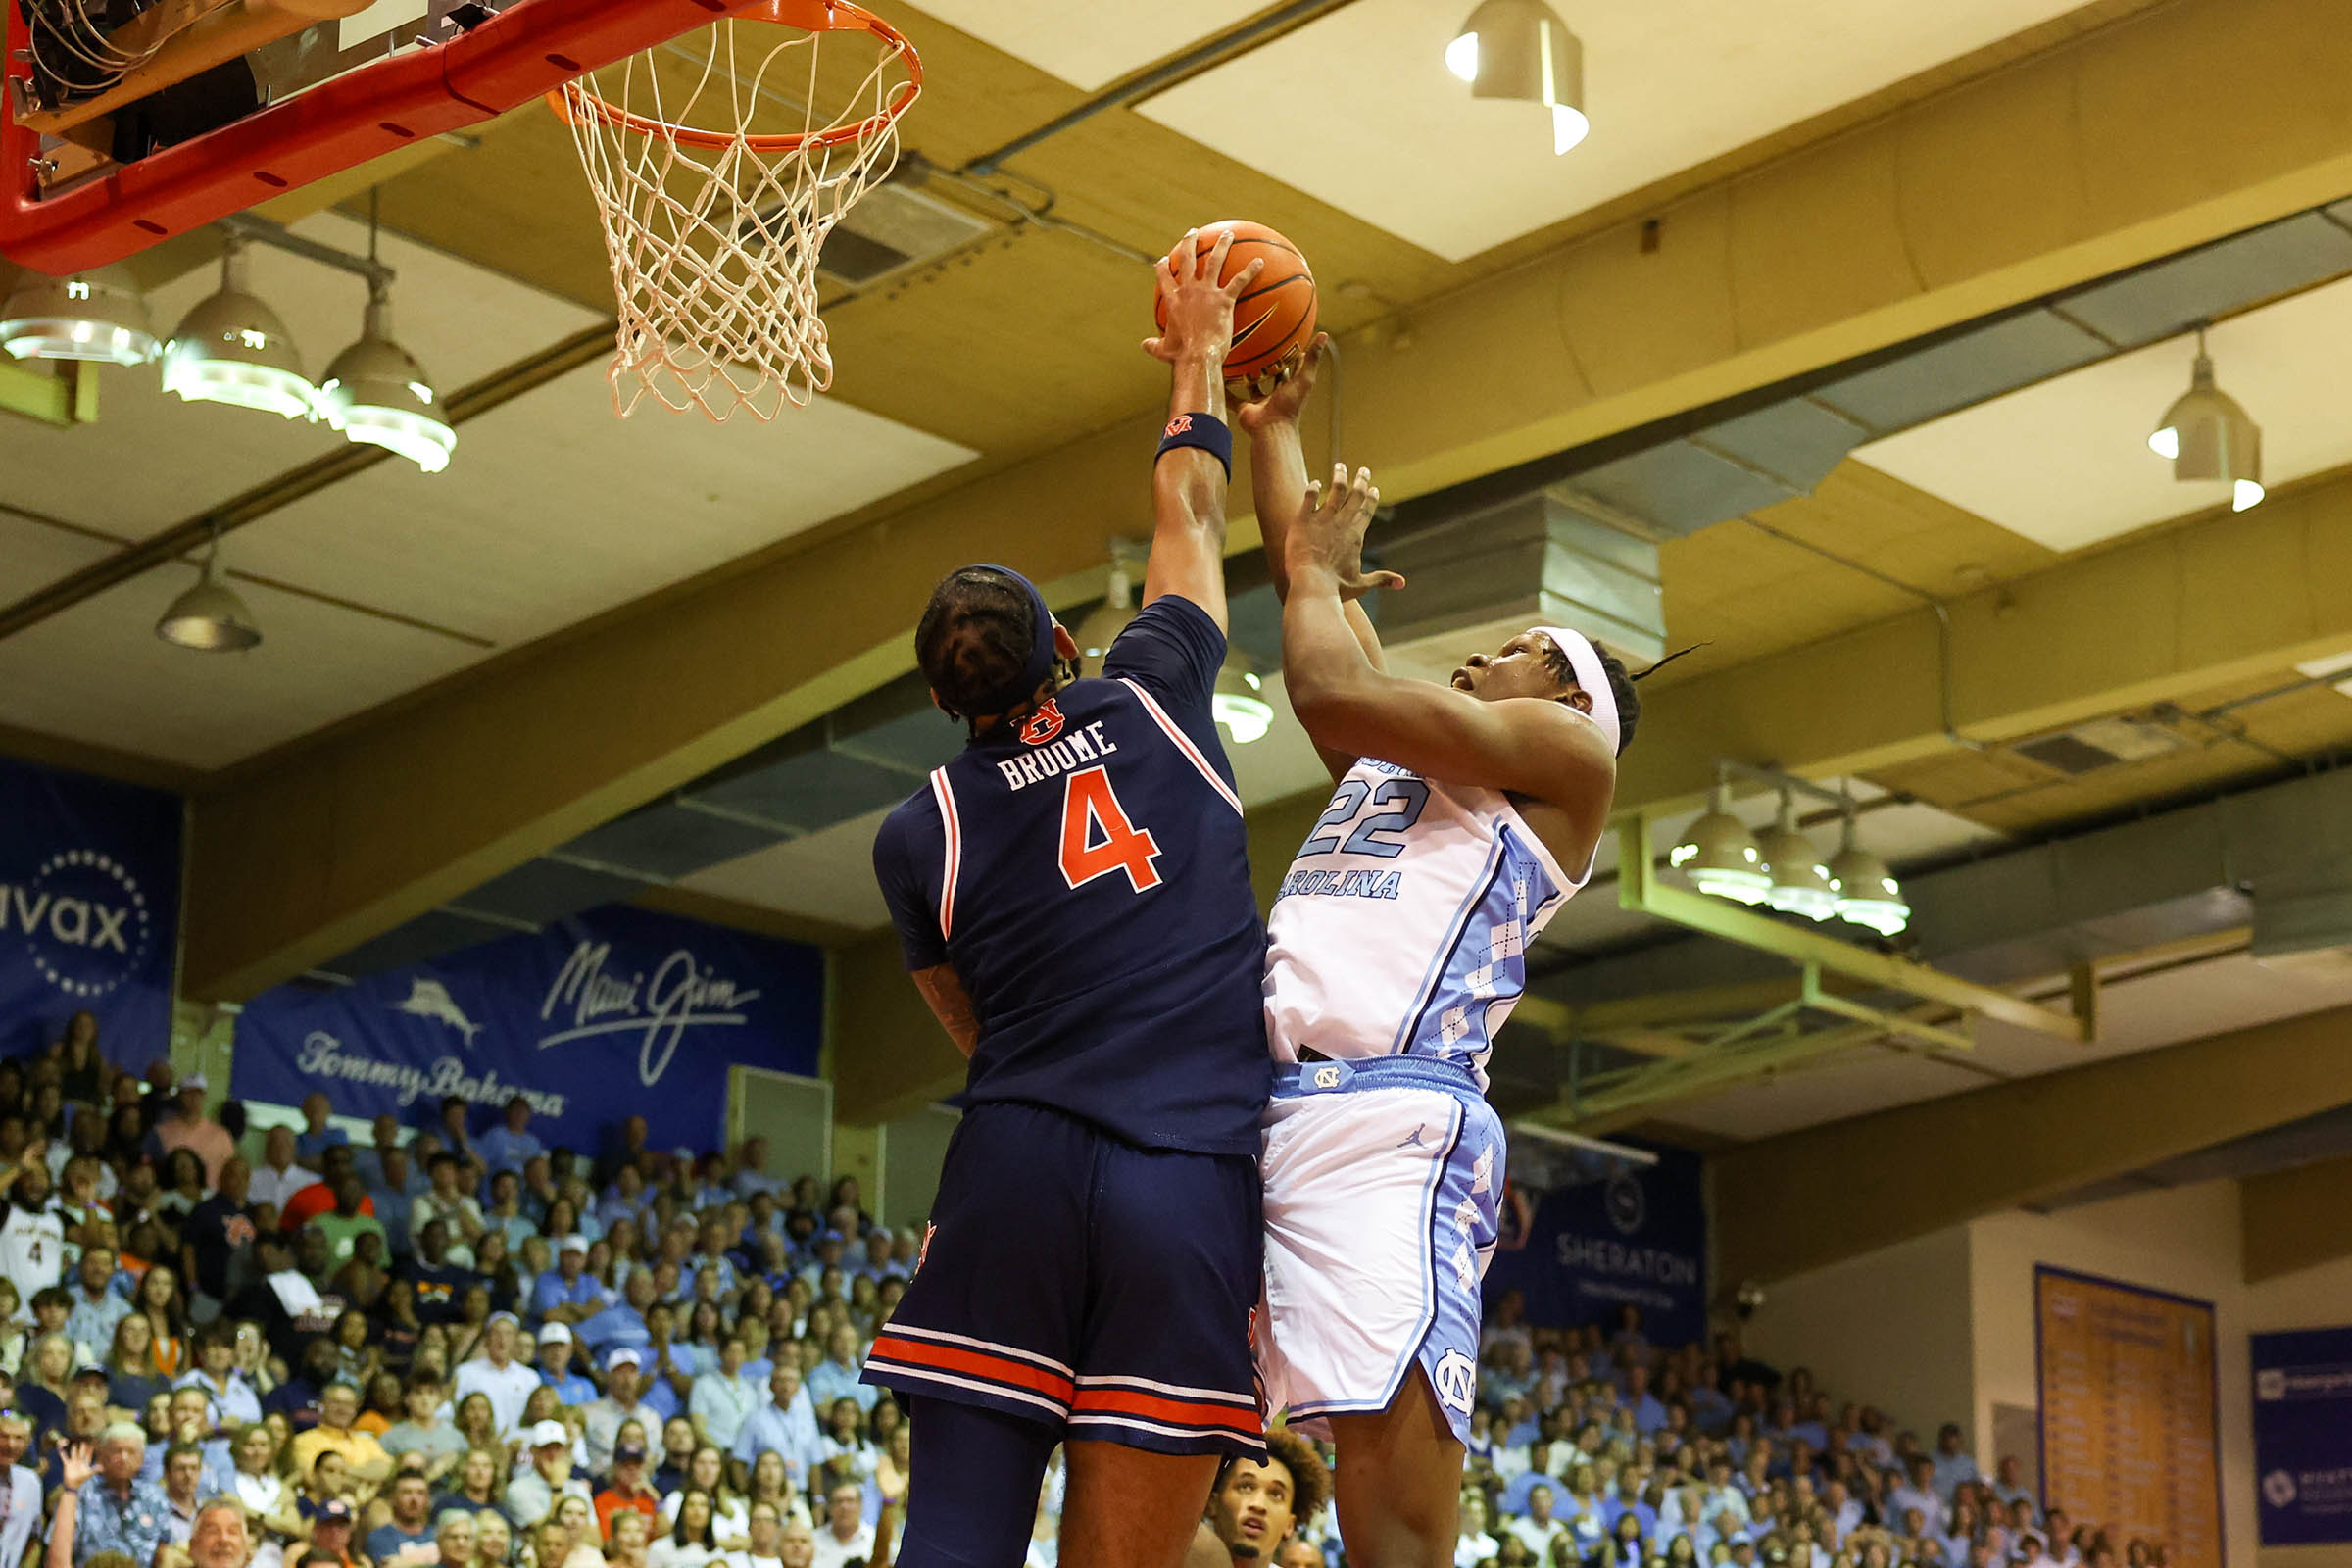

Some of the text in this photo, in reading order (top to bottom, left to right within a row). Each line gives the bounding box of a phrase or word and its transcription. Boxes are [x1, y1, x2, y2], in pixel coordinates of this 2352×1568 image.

[997, 720, 1118, 792] BROOME
[1057, 763, 1164, 895] 4
[1296, 778, 1431, 859] 22
[541, 942, 761, 1087] Maui Jim
[297, 1030, 422, 1106] Tommy
[1556, 1232, 1697, 1285] SHERATON
